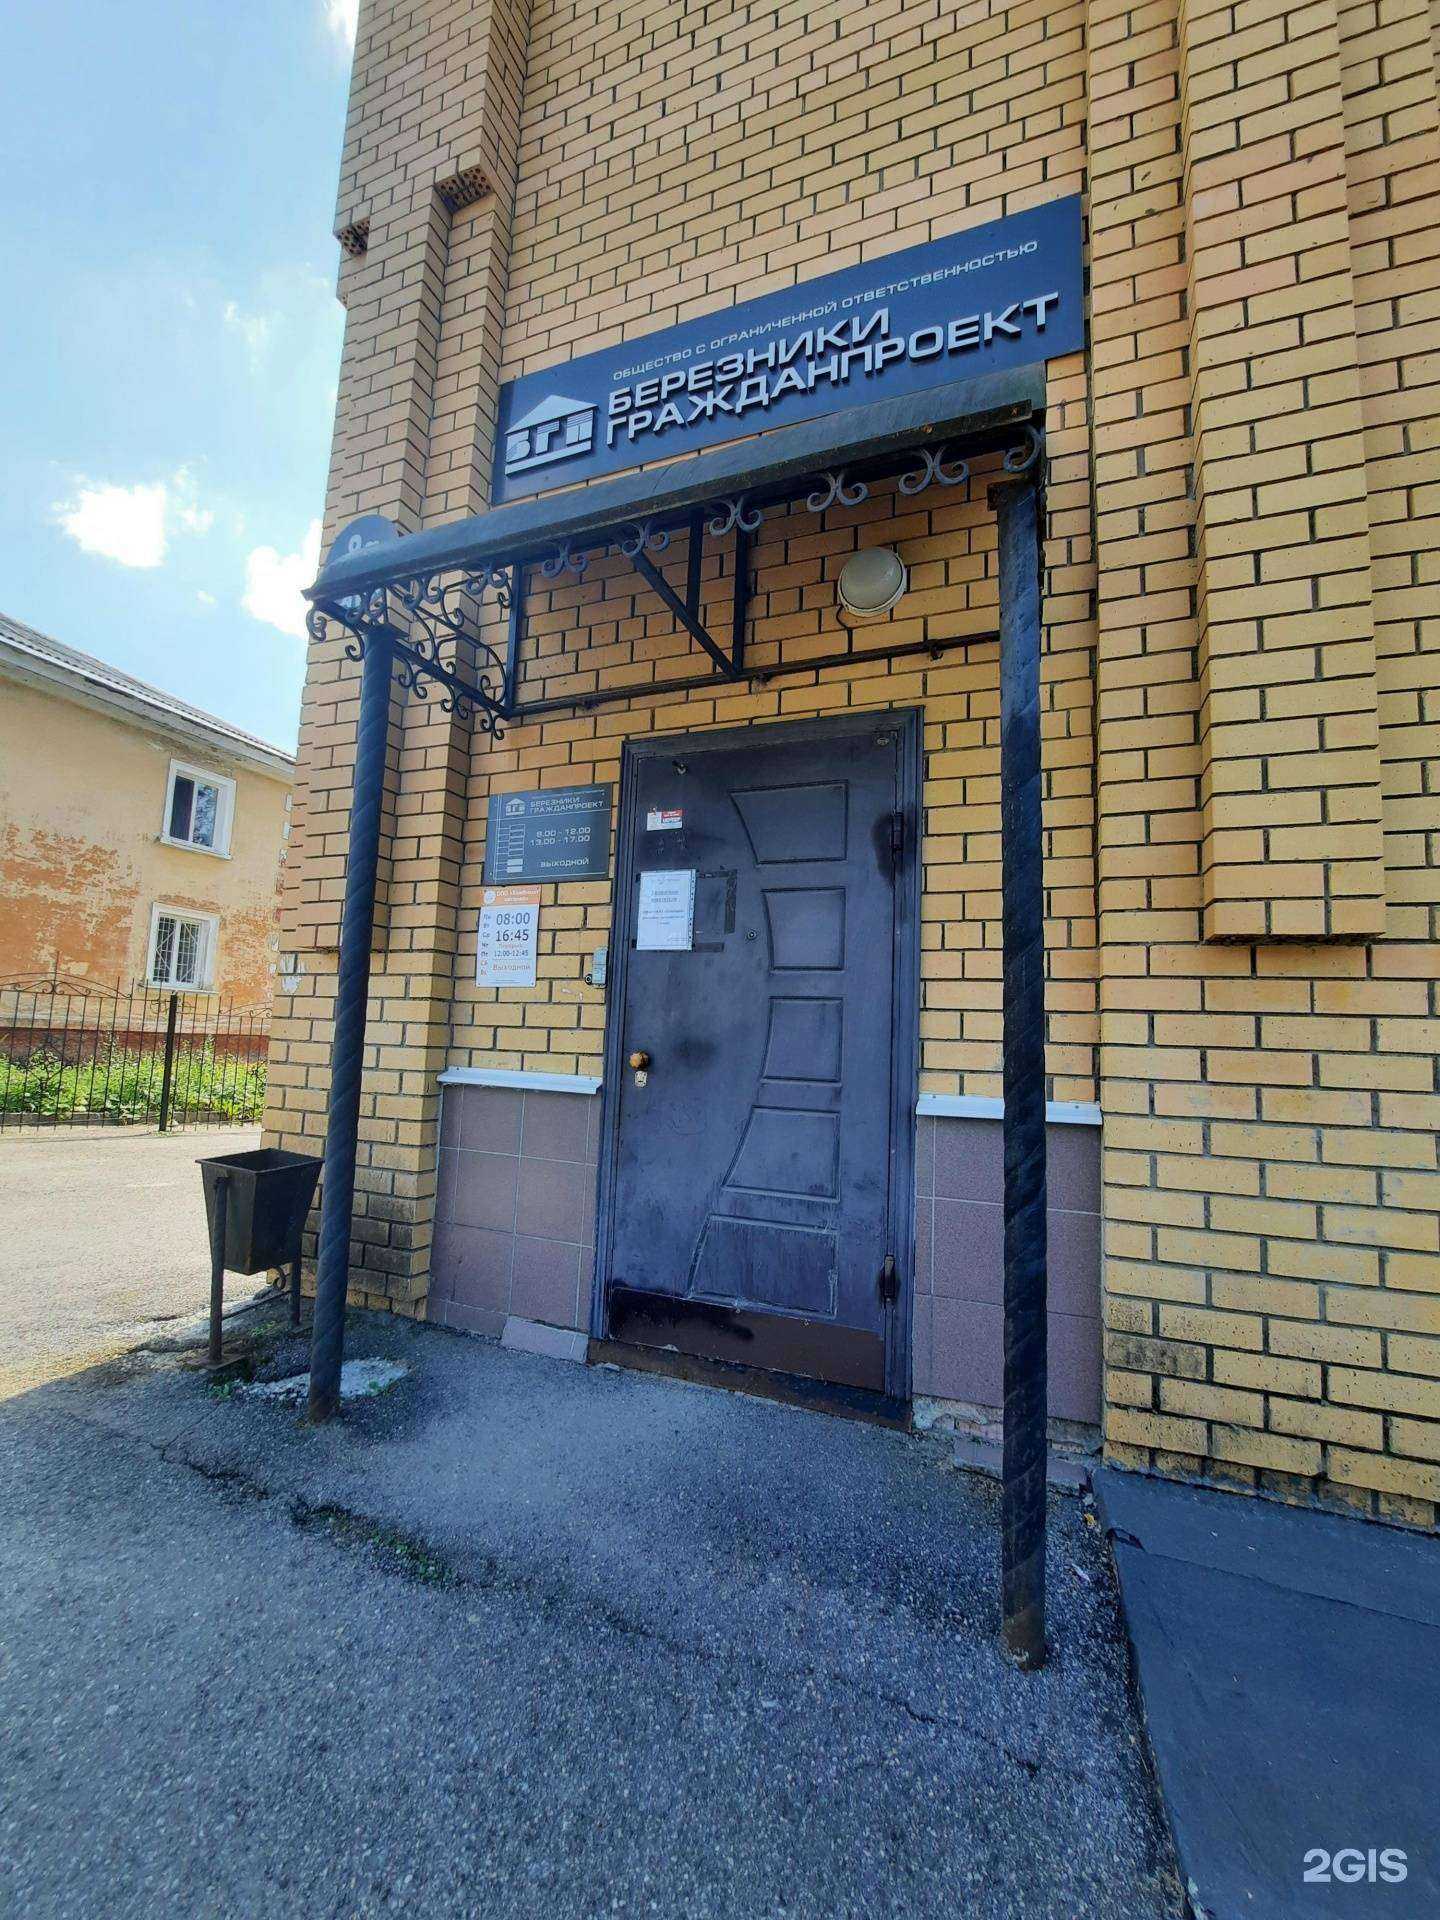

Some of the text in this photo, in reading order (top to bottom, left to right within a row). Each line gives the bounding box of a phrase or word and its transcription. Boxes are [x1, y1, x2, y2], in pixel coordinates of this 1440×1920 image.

[612, 239, 1039, 382] ОБЩЕСТВО С ОГРАНИЧЕННОЙ ОТВЕТСТВЕННОСТЬЮ
[605, 291, 1060, 446] ГРАЖДАНПРОЕКТ
[607, 307, 890, 417] БЕРЕЗНИКИ
[529, 801, 604, 814] ГРАЖДАНПРОЕКТ
[530, 797, 581, 808] БЕРЕЗНИКИ
[496, 912, 530, 926] 08:00
[495, 929, 529, 942] 16:45
